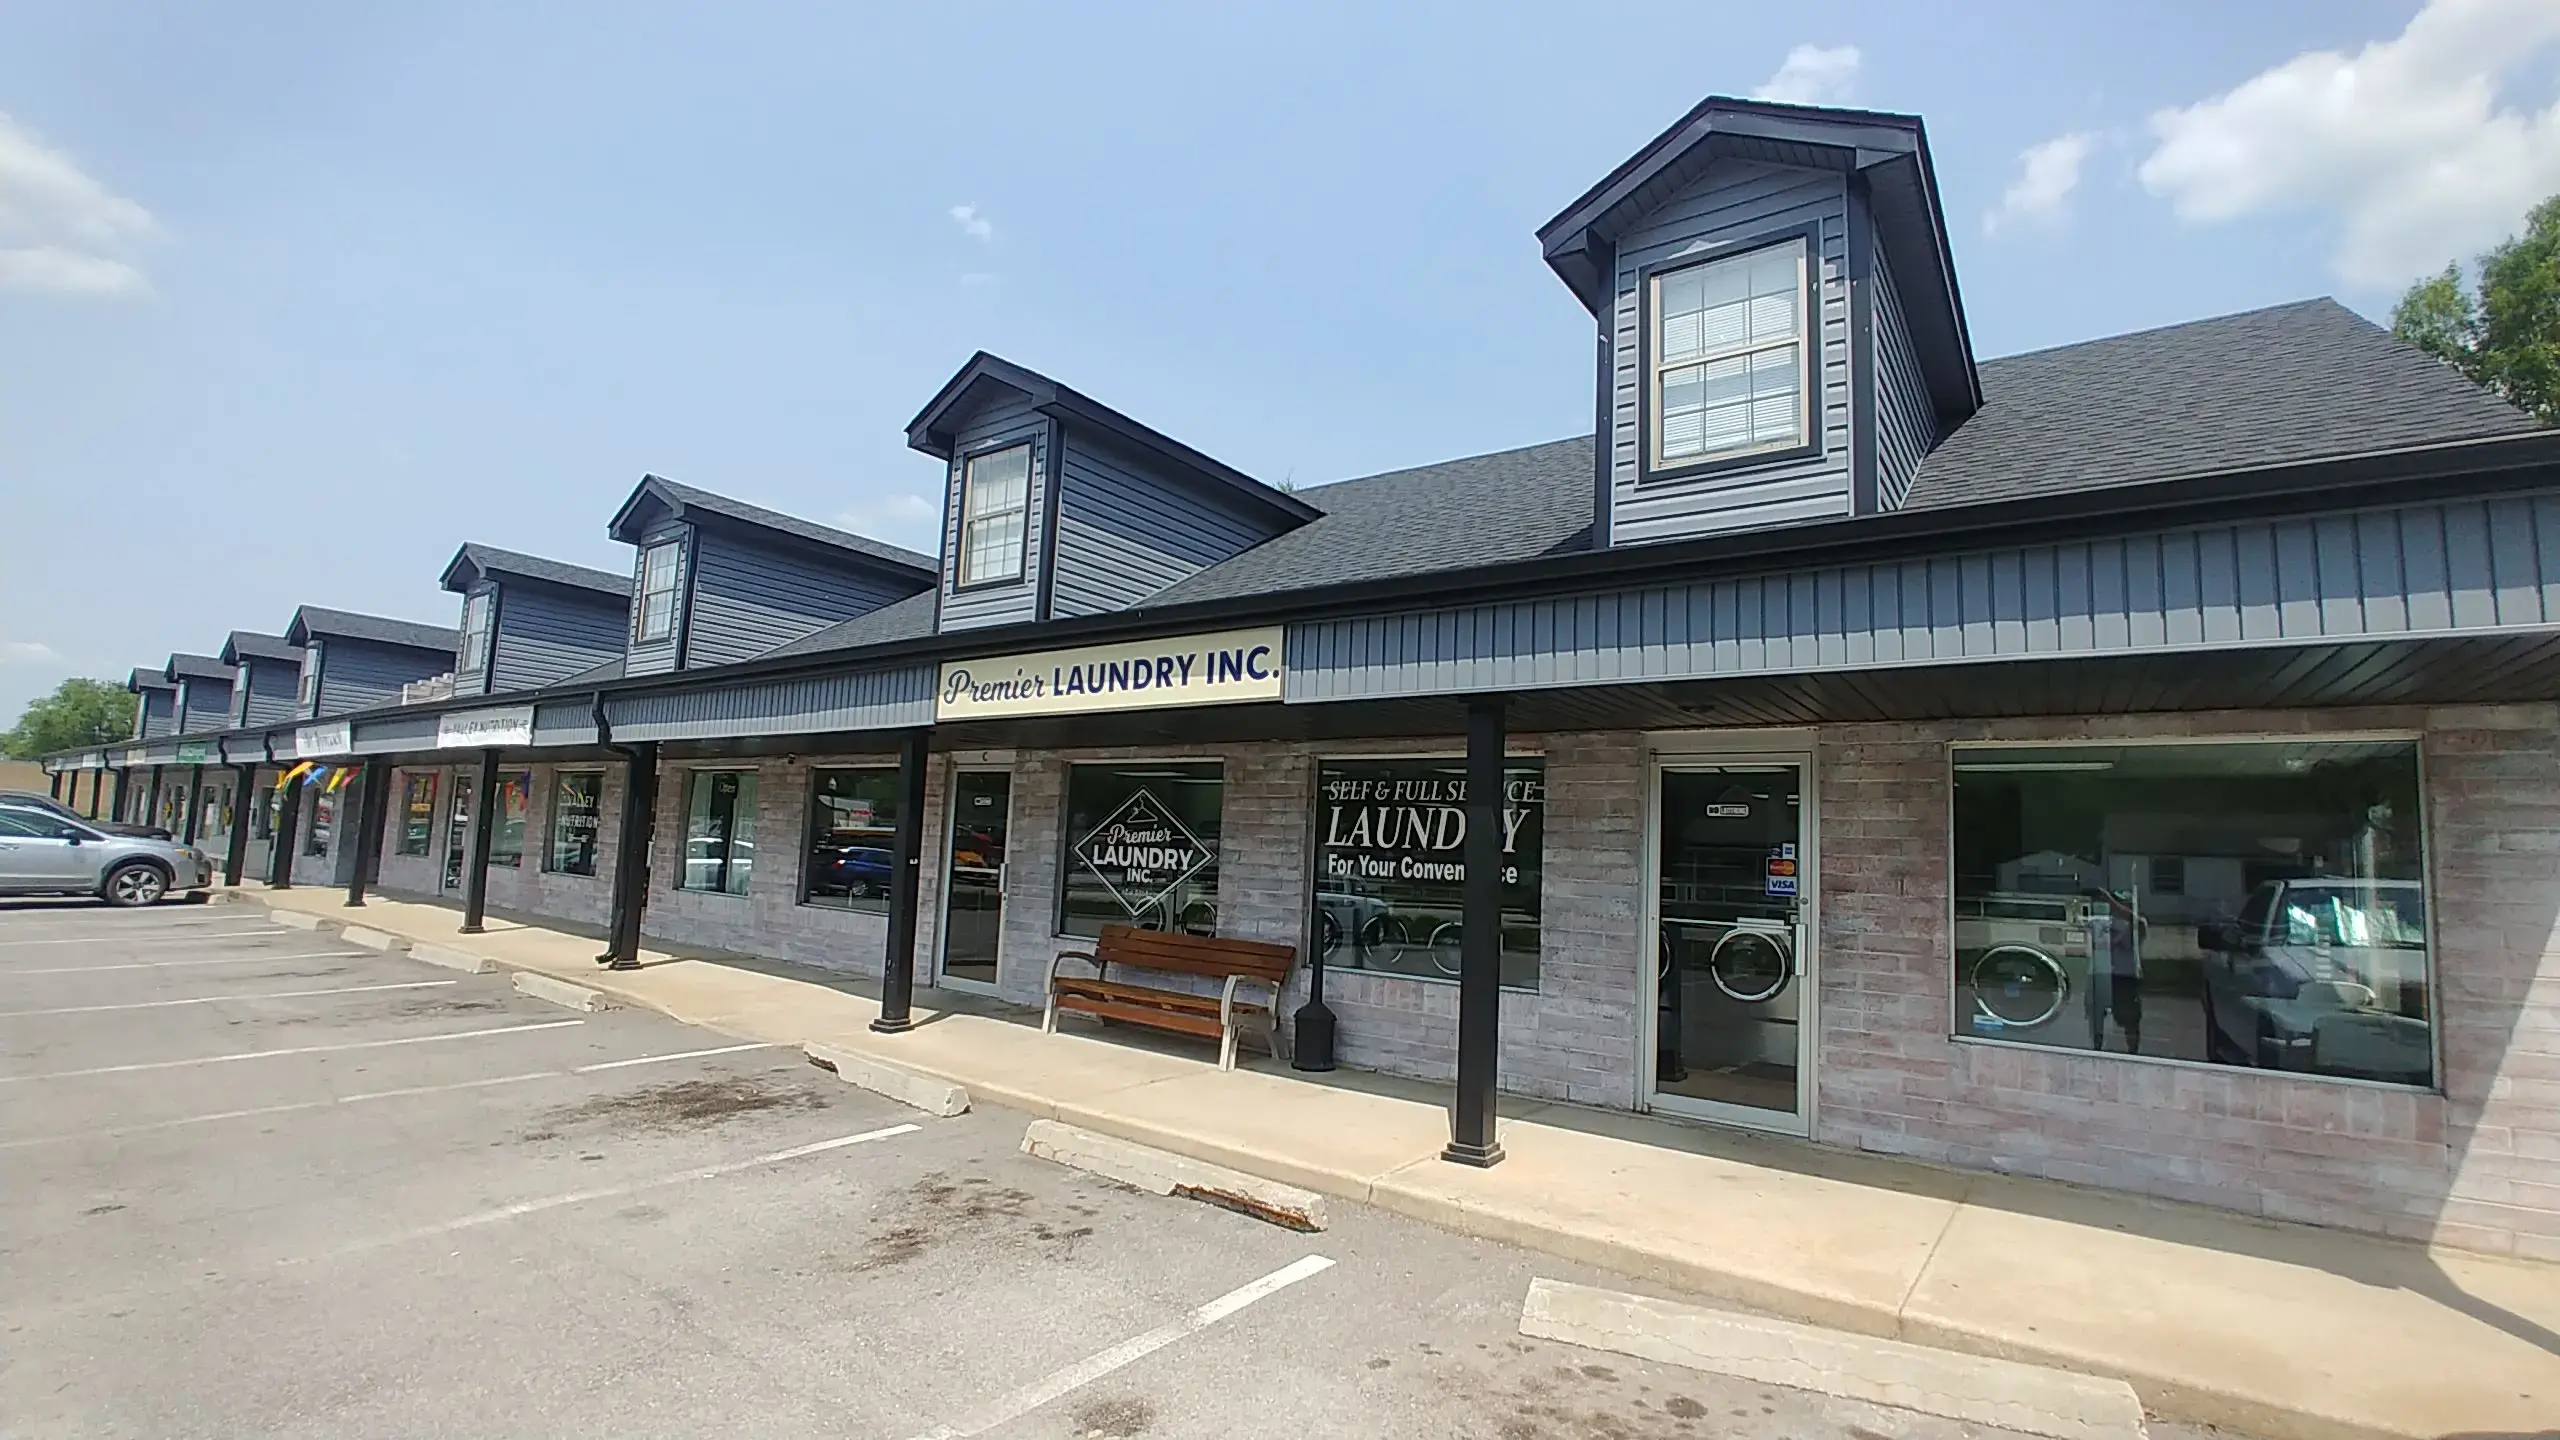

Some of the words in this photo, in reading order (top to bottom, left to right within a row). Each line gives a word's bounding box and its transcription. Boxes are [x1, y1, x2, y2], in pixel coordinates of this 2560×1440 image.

[943, 668, 1045, 705] Premier
[1053, 653, 1197, 697] LAUNDRY
[1206, 645, 1280, 685] INC.
[1328, 780, 1373, 800] SELF
[1374, 781, 1391, 800] &
[1393, 780, 1442, 800] FULL
[1107, 824, 1172, 845] Premier
[1325, 806, 1532, 854] LAUNDY
[1093, 845, 1193, 871] LAUNDRY
[1328, 853, 1354, 875] For
[1358, 854, 1397, 878] Your
[1127, 867, 1153, 883] INC.
[1771, 880, 1795, 889] VISA
